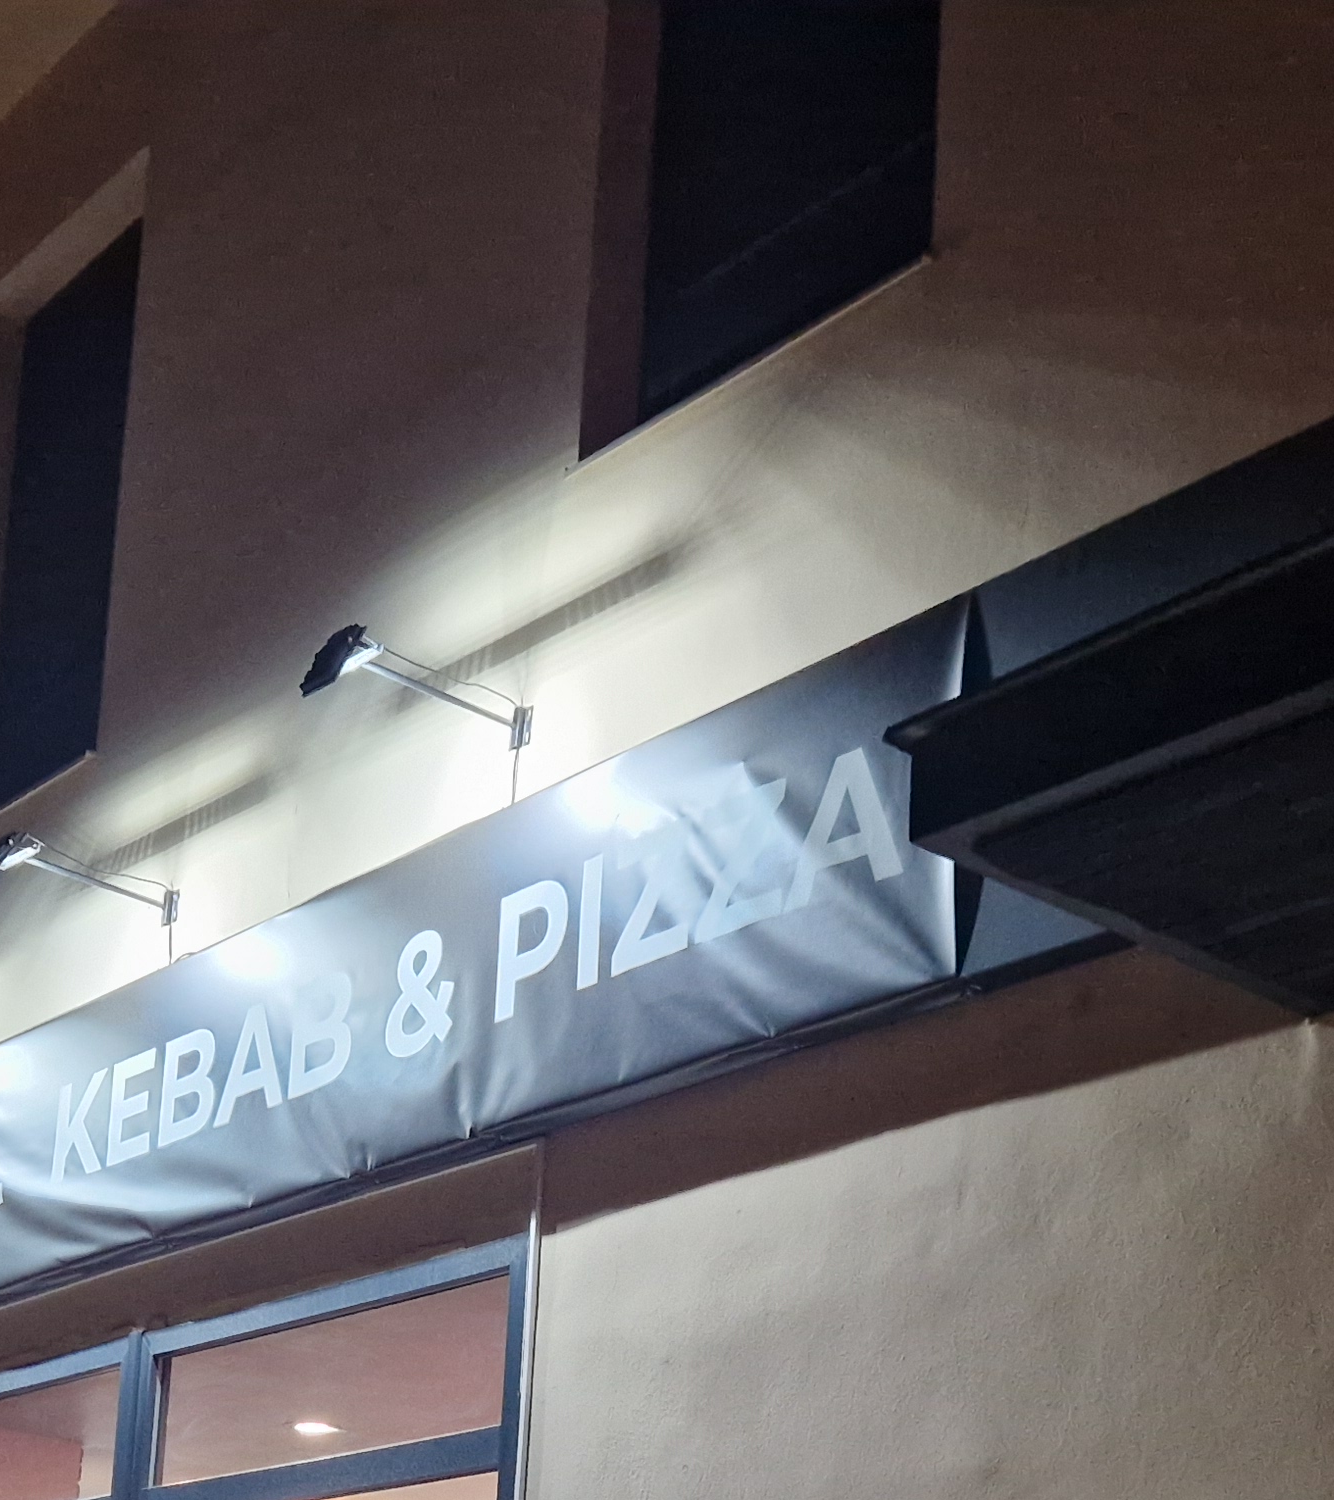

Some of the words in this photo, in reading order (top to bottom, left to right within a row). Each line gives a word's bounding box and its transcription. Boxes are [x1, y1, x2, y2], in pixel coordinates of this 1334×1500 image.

[50, 972, 352, 1183] KEBAB
[385, 930, 454, 1058] &
[494, 747, 903, 1023] PIZZA
